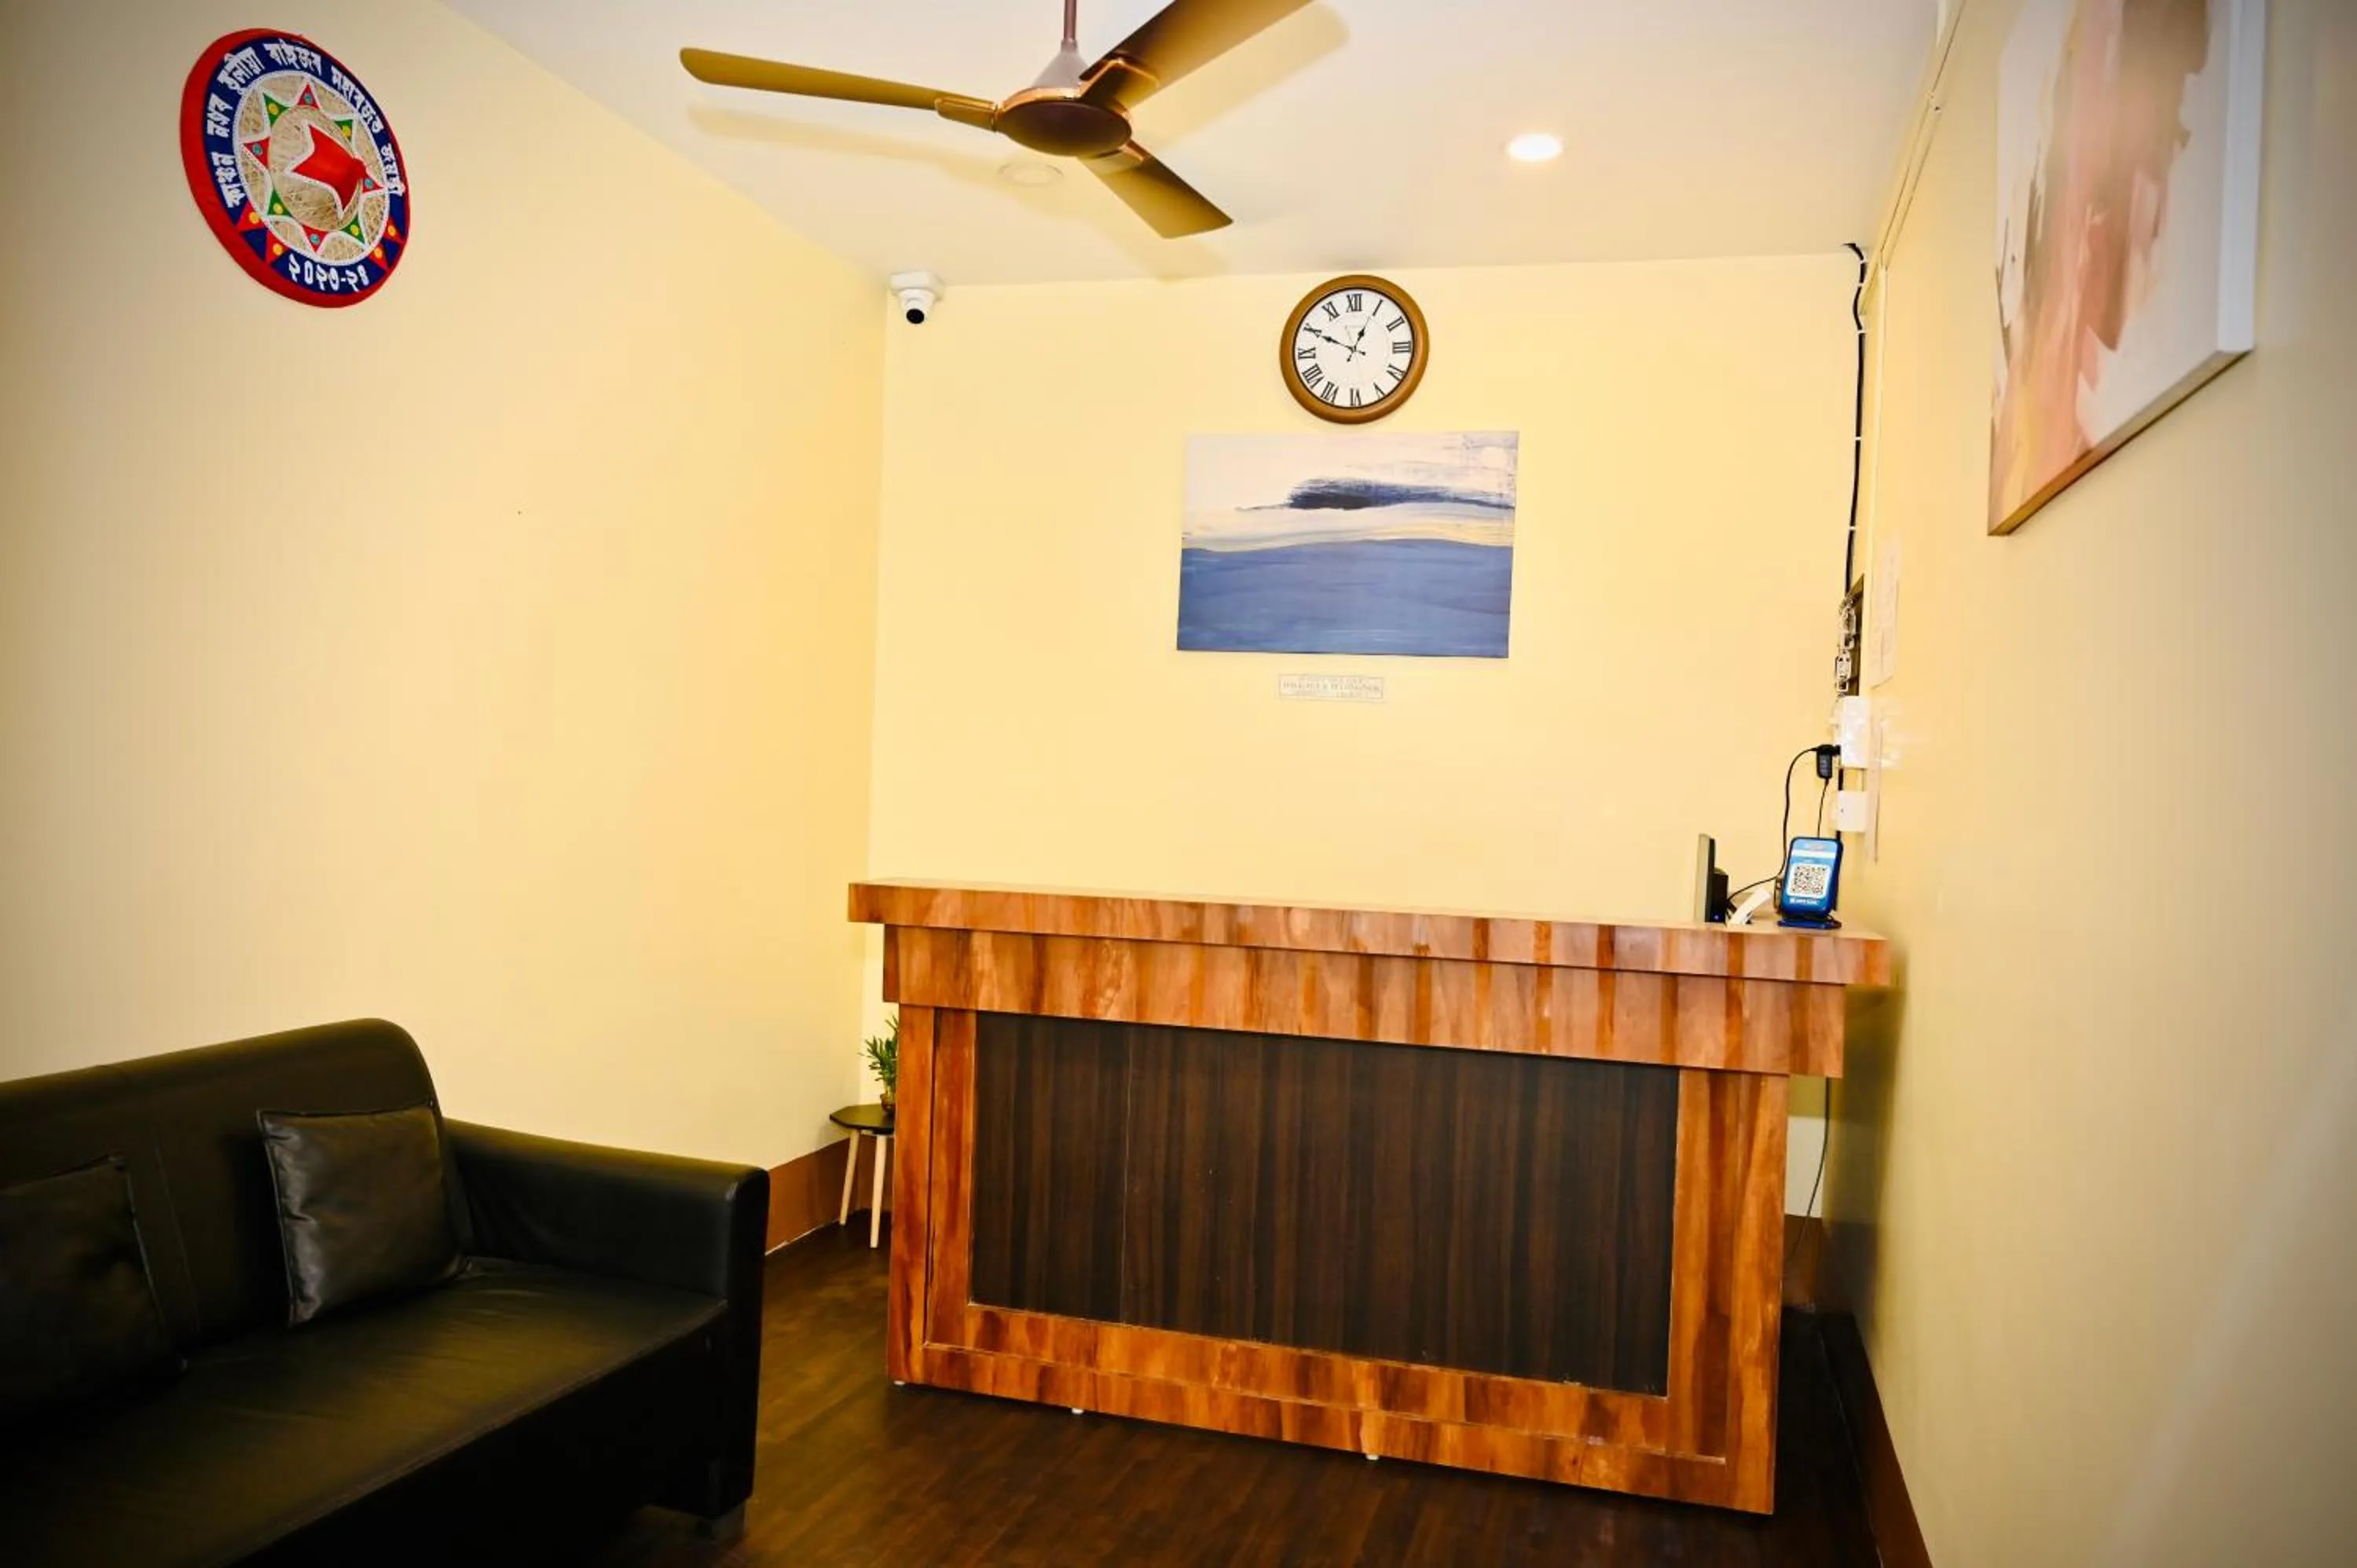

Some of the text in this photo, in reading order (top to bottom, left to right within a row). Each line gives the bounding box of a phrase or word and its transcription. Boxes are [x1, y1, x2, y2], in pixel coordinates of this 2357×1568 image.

[1321, 301, 1340, 321] XI
[1346, 293, 1362, 313] XII
[1372, 299, 1384, 317] I
[1303, 322, 1322, 339] X
[1386, 316, 1405, 332] II
[1298, 346, 1316, 359] IX
[1392, 341, 1412, 354] III
[1301, 363, 1325, 390] VIII
[1386, 364, 1405, 382] IV
[1320, 381, 1339, 404] VII
[1350, 388, 1362, 406] VI
